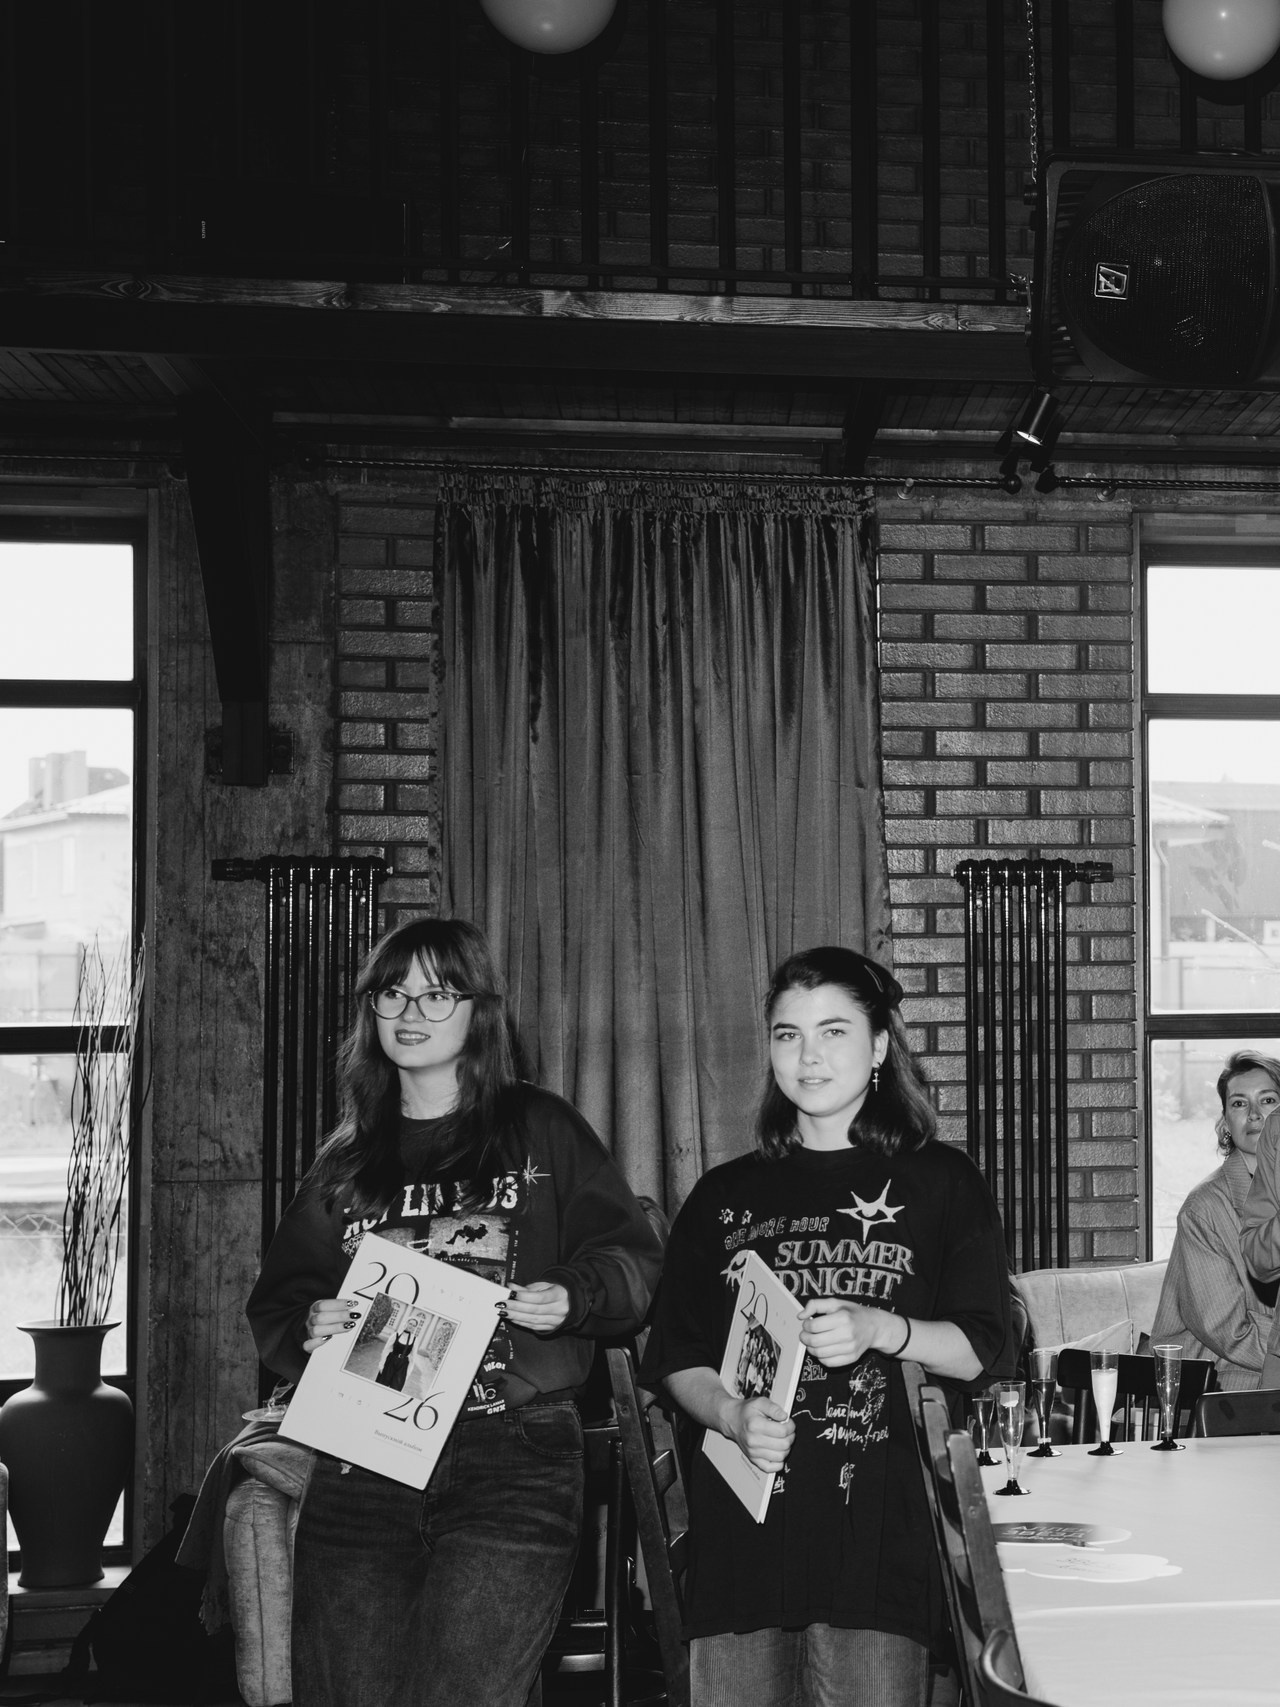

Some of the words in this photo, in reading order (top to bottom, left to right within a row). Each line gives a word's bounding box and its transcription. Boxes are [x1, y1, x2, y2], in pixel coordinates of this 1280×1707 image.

[789, 1216, 830, 1233] HOUR
[774, 1238, 915, 1276] SUMMER
[352, 1261, 420, 1305] 20
[774, 1266, 903, 1301] DNIGHT
[740, 1280, 769, 1327] 20
[382, 1391, 445, 1431] 26
[486, 1403, 506, 1415] GNX
